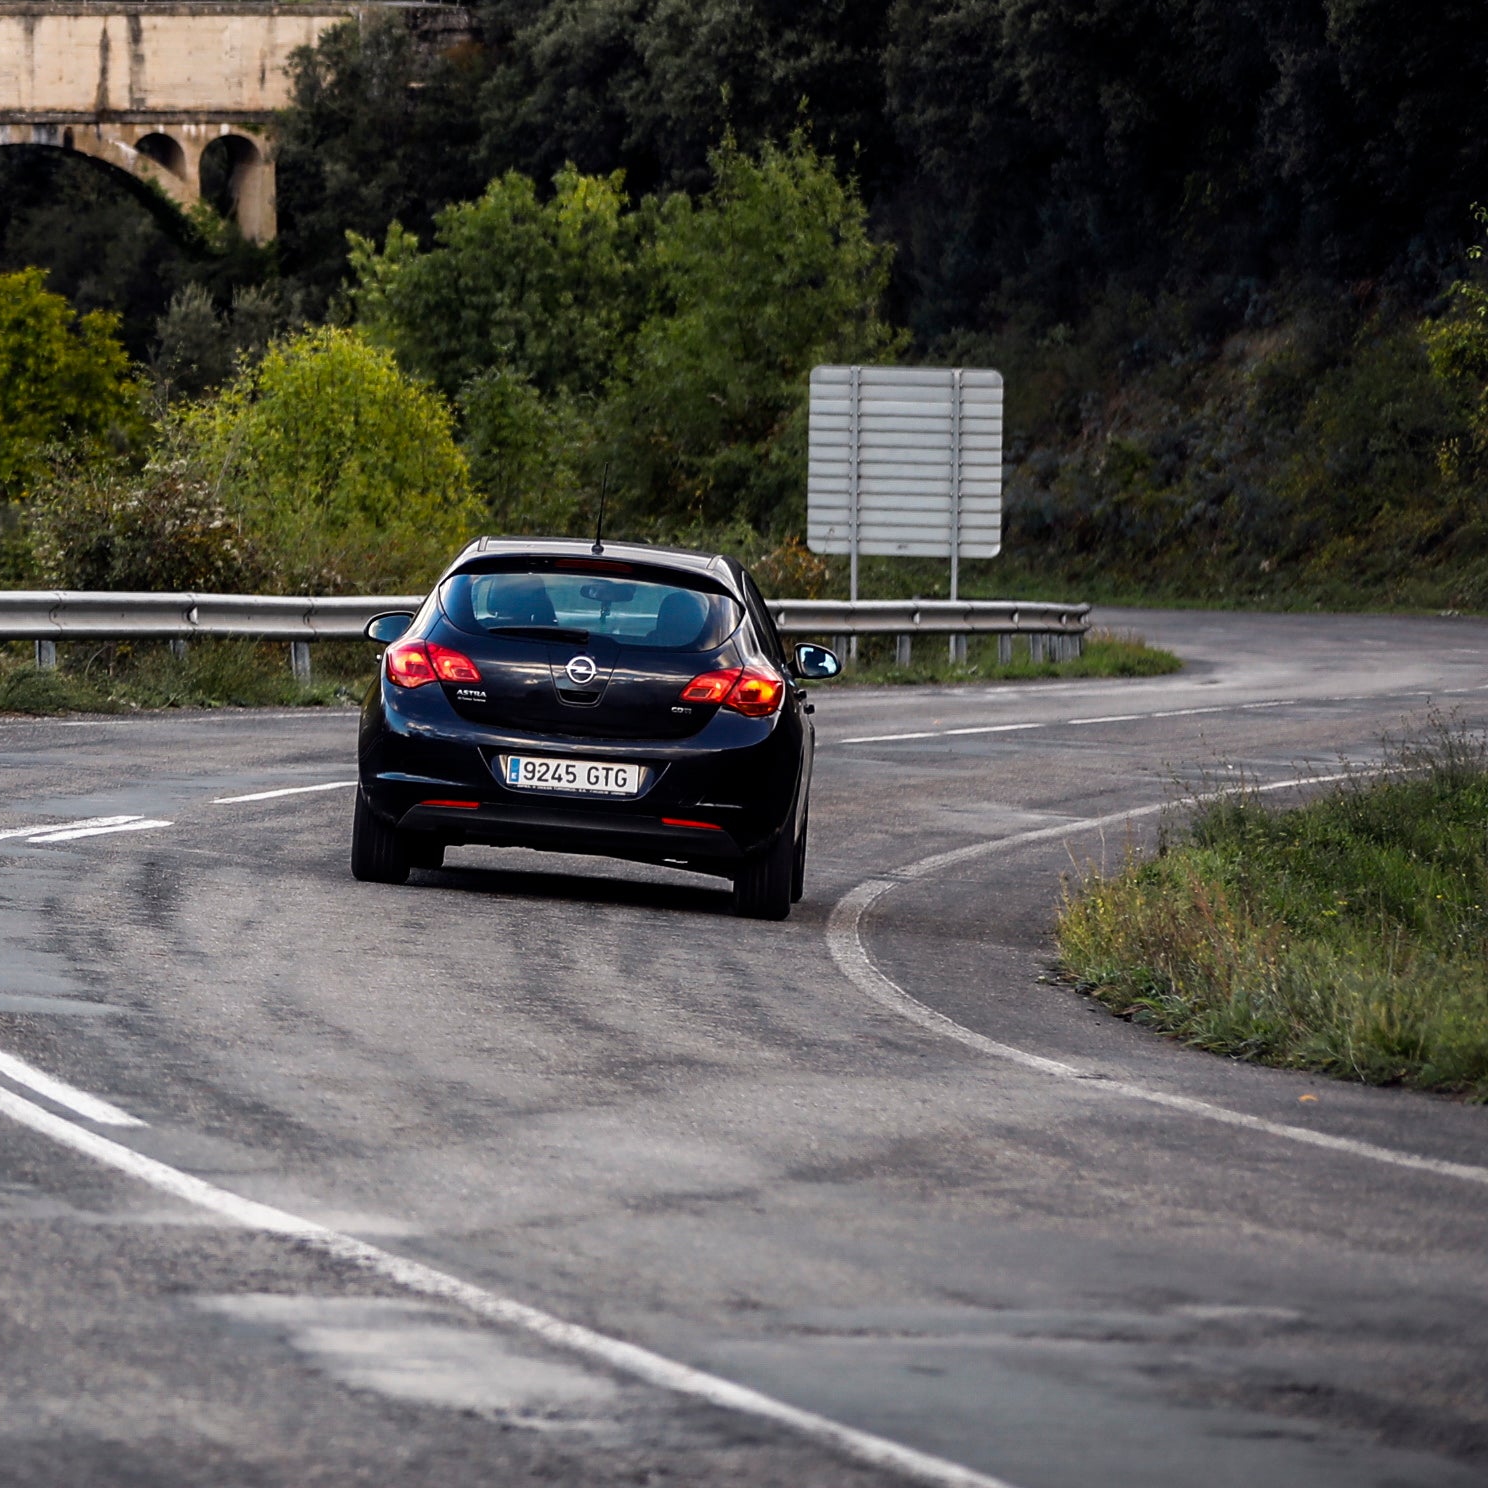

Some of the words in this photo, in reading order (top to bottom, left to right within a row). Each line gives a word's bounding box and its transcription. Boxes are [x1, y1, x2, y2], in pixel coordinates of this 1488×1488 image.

[456, 689, 487, 697] ASTRA
[523, 761, 577, 784] 9245
[586, 766, 627, 788] GTG
